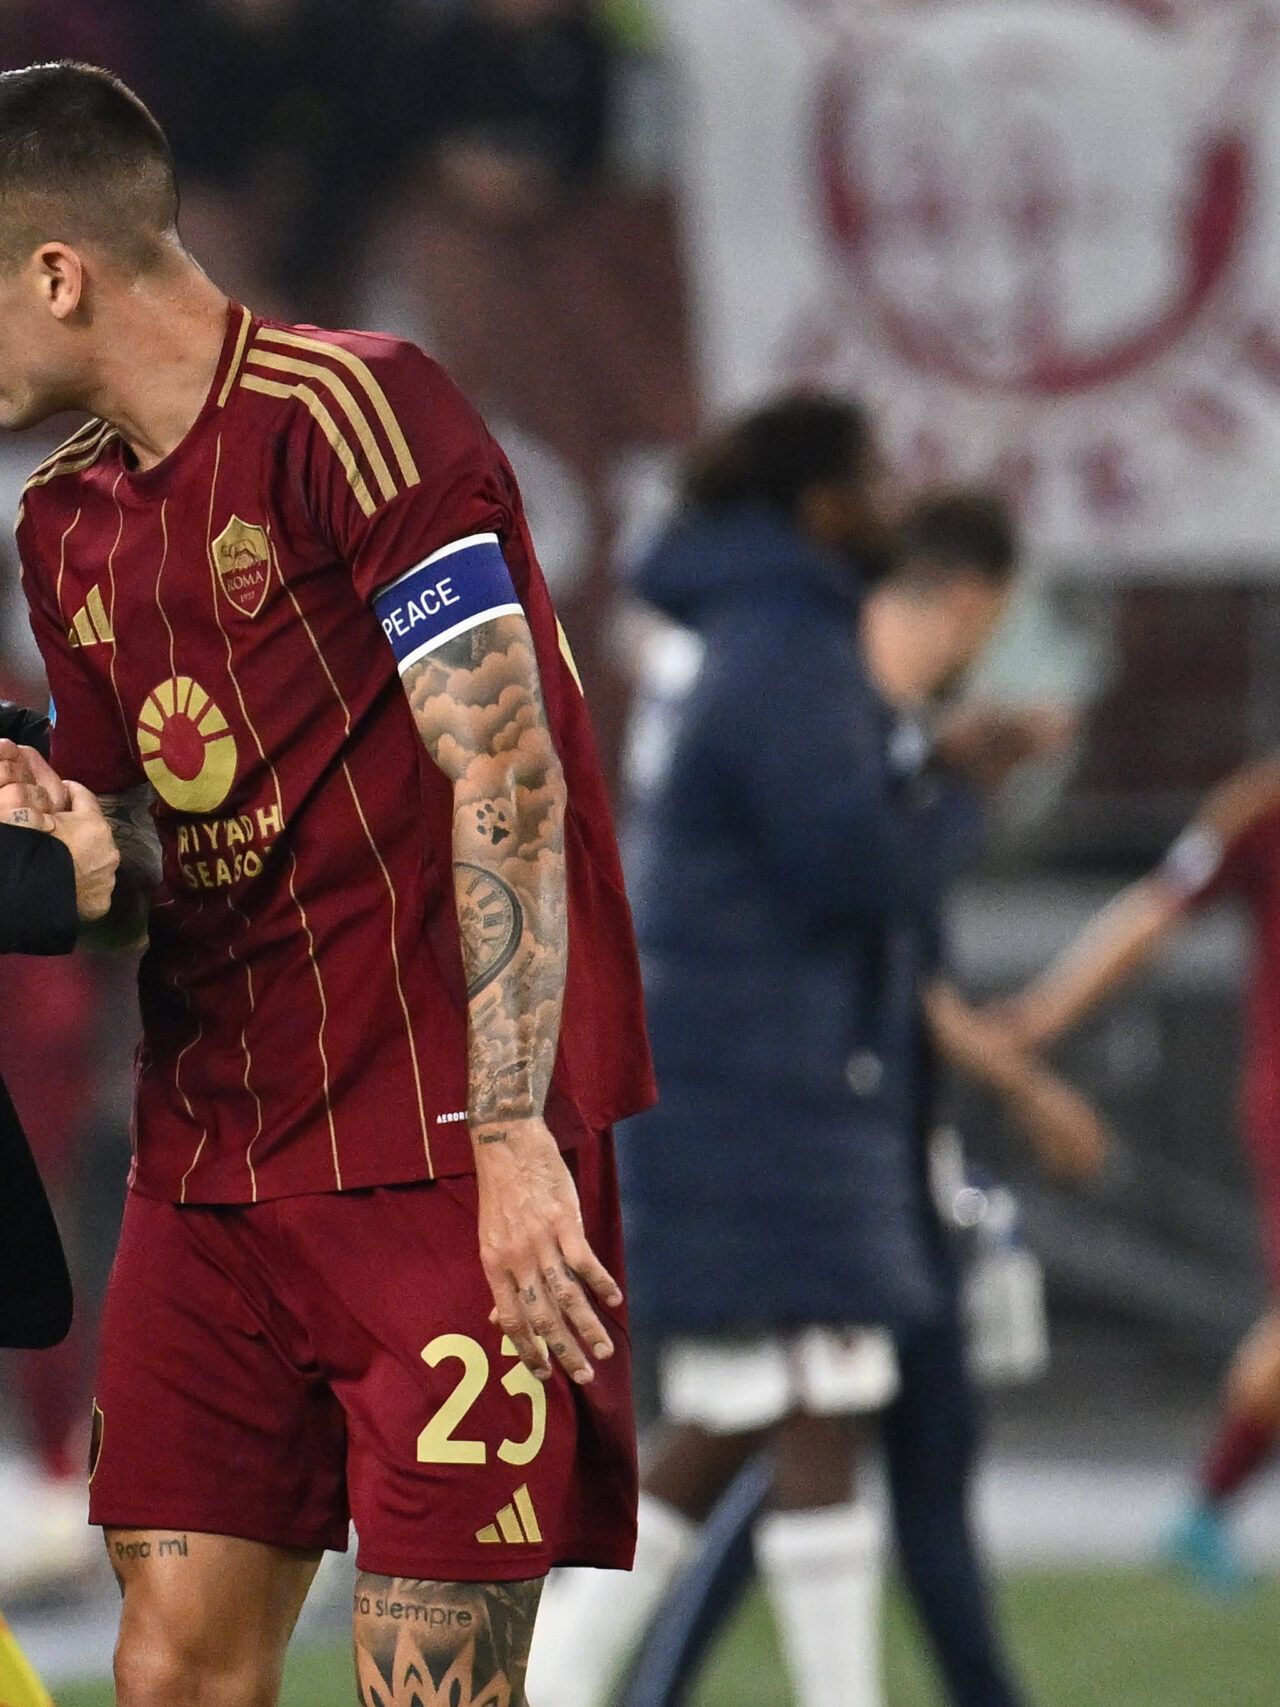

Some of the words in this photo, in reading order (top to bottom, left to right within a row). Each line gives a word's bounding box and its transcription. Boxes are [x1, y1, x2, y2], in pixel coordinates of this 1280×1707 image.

[226, 570, 265, 593] ROMA
[381, 577, 461, 645] PEACE
[178, 804, 281, 855] RIYADH
[183, 846, 271, 889] SEASO
[417, 1333, 549, 1466] 23
[159, 1534, 188, 1558] mi
[375, 1600, 472, 1629] siempre
